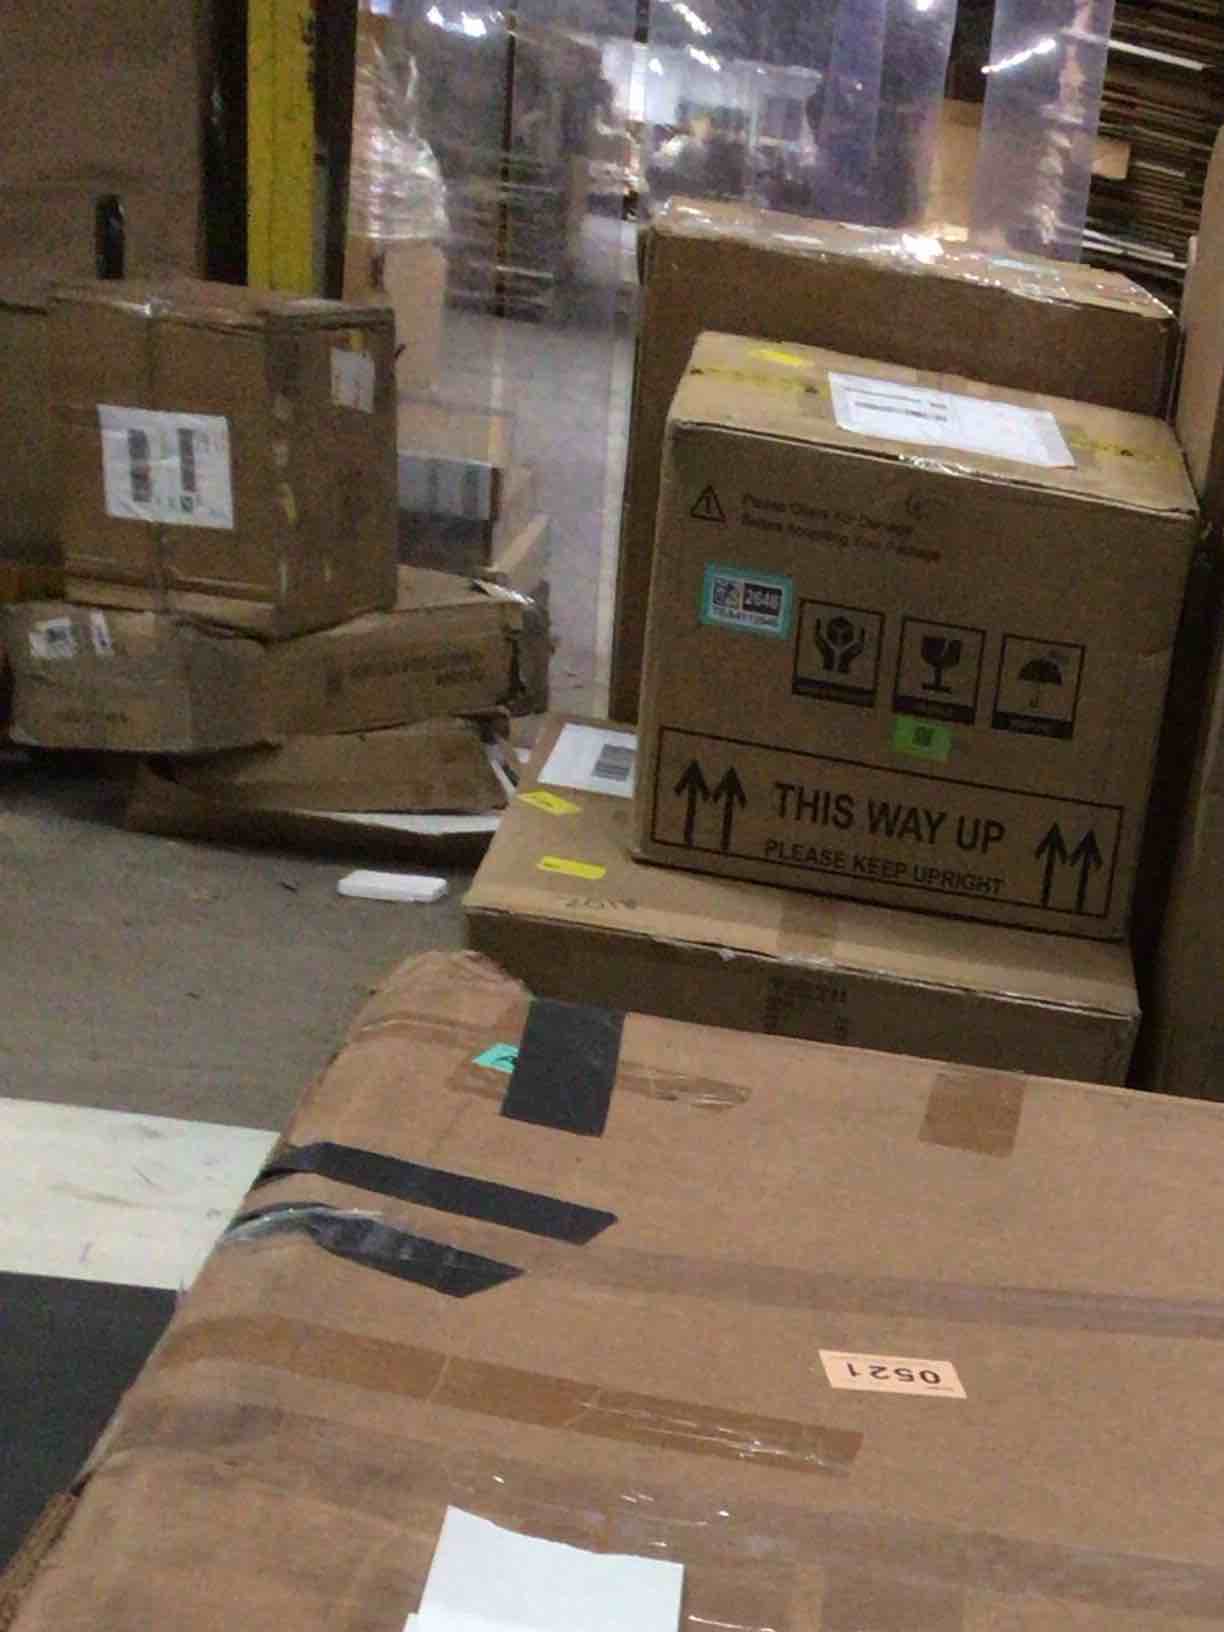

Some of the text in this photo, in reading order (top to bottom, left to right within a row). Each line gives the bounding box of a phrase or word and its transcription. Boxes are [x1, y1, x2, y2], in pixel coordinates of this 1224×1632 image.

[773, 781, 1006, 854] THIS WAY UP
[763, 838, 1006, 895] PLEASE KEEP UPRIGHT
[846, 1361, 942, 1385] 0521
